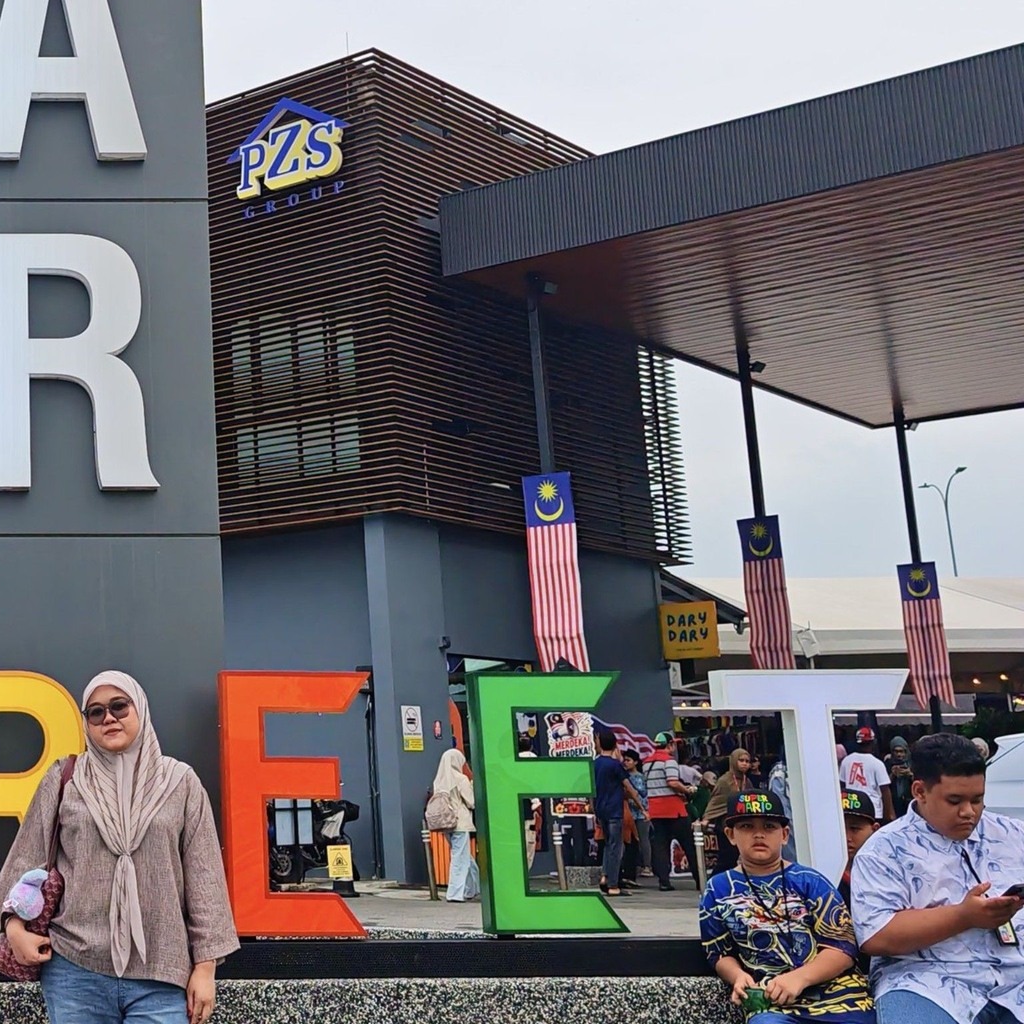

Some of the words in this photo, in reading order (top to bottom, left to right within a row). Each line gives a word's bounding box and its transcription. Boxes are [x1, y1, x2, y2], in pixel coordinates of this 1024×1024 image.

[236, 119, 342, 199] PZS
[244, 180, 344, 219] GROUP
[667, 611, 707, 627] DARY
[668, 627, 709, 643] DARY
[739, 794, 768, 803] SUPER
[842, 798, 861, 809] RIO
[736, 801, 773, 814] MARIO
